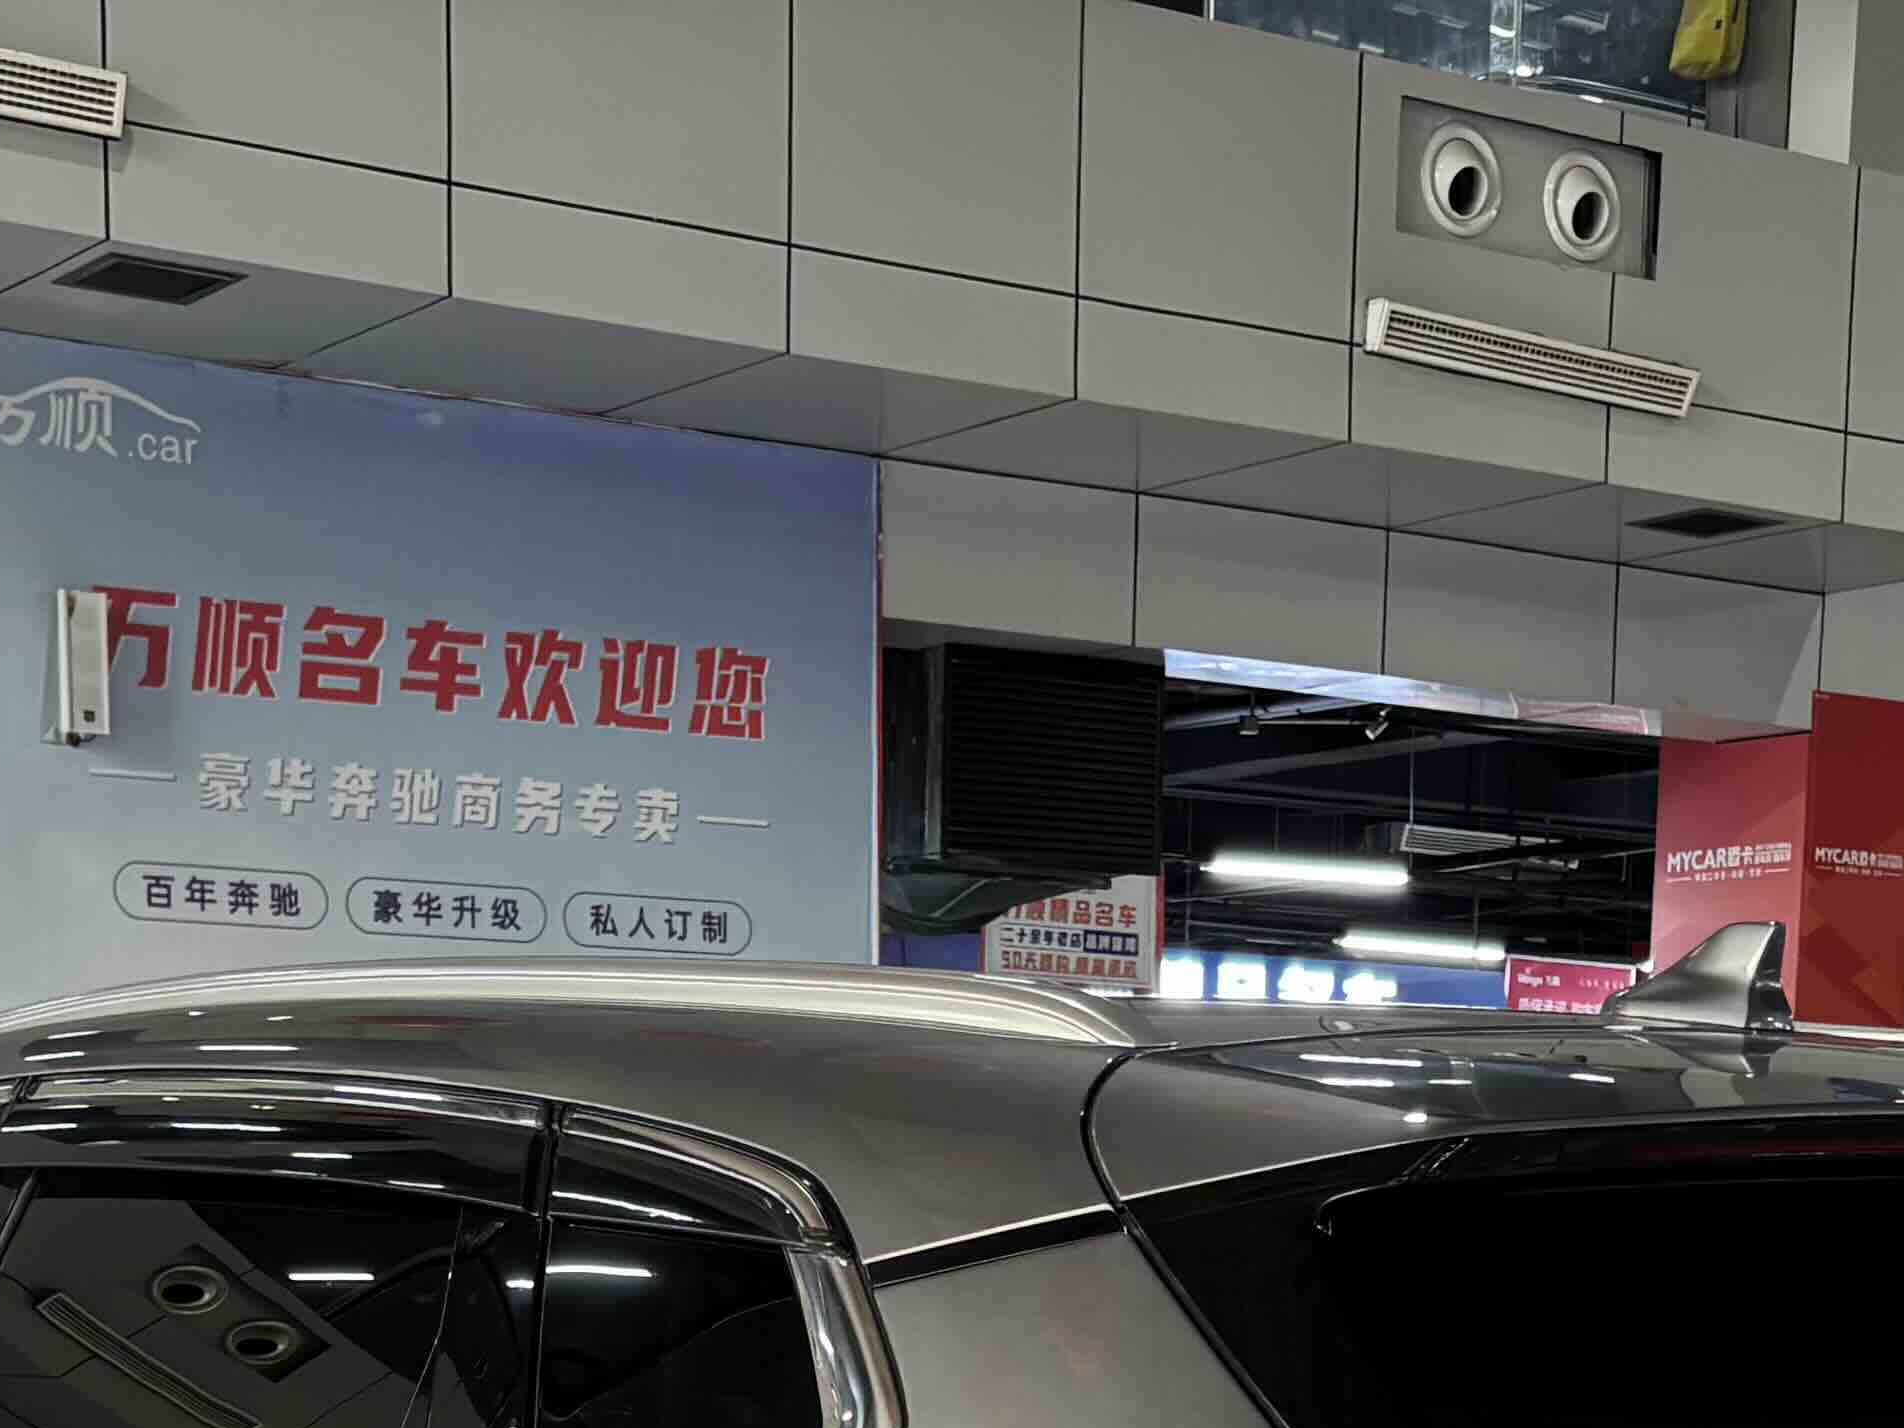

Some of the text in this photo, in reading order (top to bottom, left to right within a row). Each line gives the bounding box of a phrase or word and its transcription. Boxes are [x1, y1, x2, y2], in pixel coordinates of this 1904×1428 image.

[94, 584, 774, 742] 万顺名车欢迎您
[197, 752, 682, 845] 豪华奔驰商务专卖
[142, 874, 730, 947] 百年奔驰 豪华升级 私人订制
